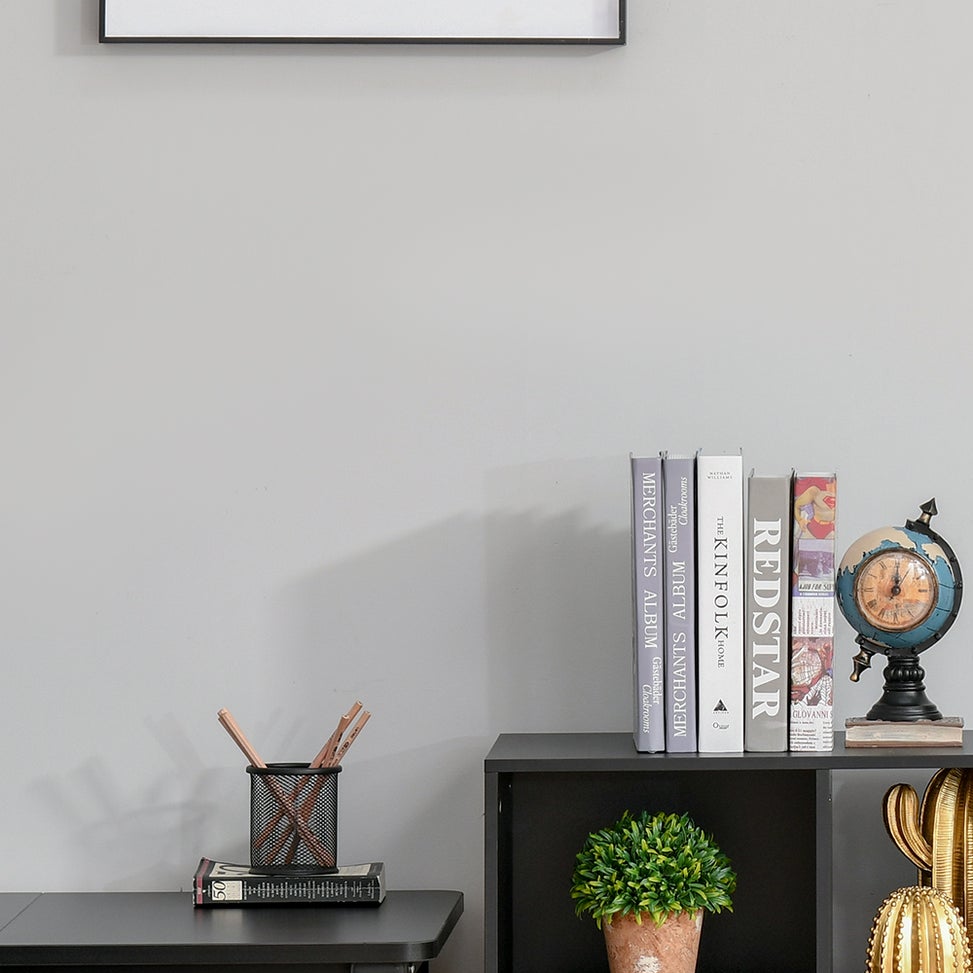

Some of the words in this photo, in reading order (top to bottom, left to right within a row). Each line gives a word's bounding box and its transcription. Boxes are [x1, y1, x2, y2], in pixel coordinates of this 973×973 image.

[642, 472, 657, 577] MERCHANTS
[678, 476, 688, 526] Cloakrooms
[716, 516, 724, 535] THE
[672, 560, 686, 620] ALBUM
[714, 537, 728, 639] KINFOLK
[643, 590, 658, 649] ALBUM
[753, 518, 781, 720] REDSTAR
[717, 640, 725, 668] HOME
[673, 632, 687, 737] MERCHANTS
